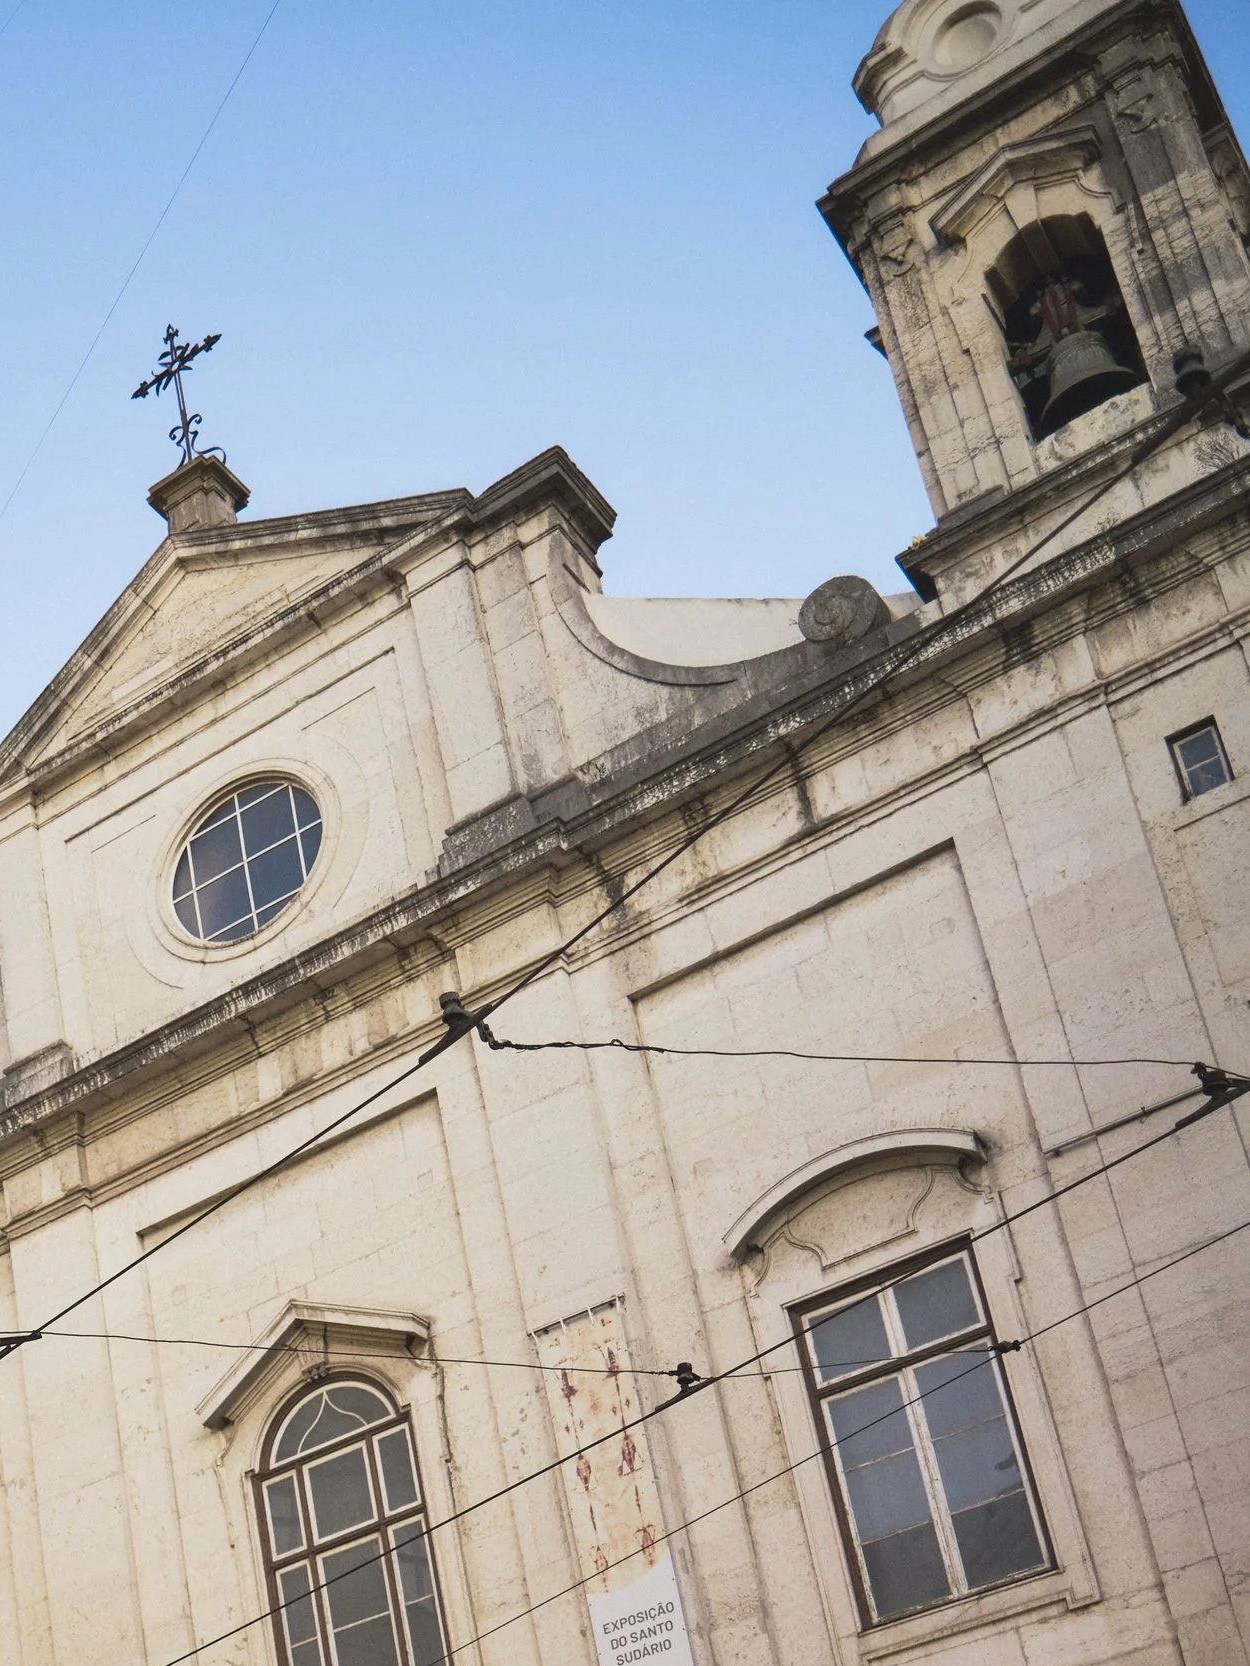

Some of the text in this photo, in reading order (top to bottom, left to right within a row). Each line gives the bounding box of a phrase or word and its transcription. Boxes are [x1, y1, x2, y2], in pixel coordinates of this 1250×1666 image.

[602, 1601, 675, 1635] EXPOSIÇÃO
[610, 1620, 674, 1650] DO SANTO
[616, 1638, 672, 1666] SUDÁRIO
